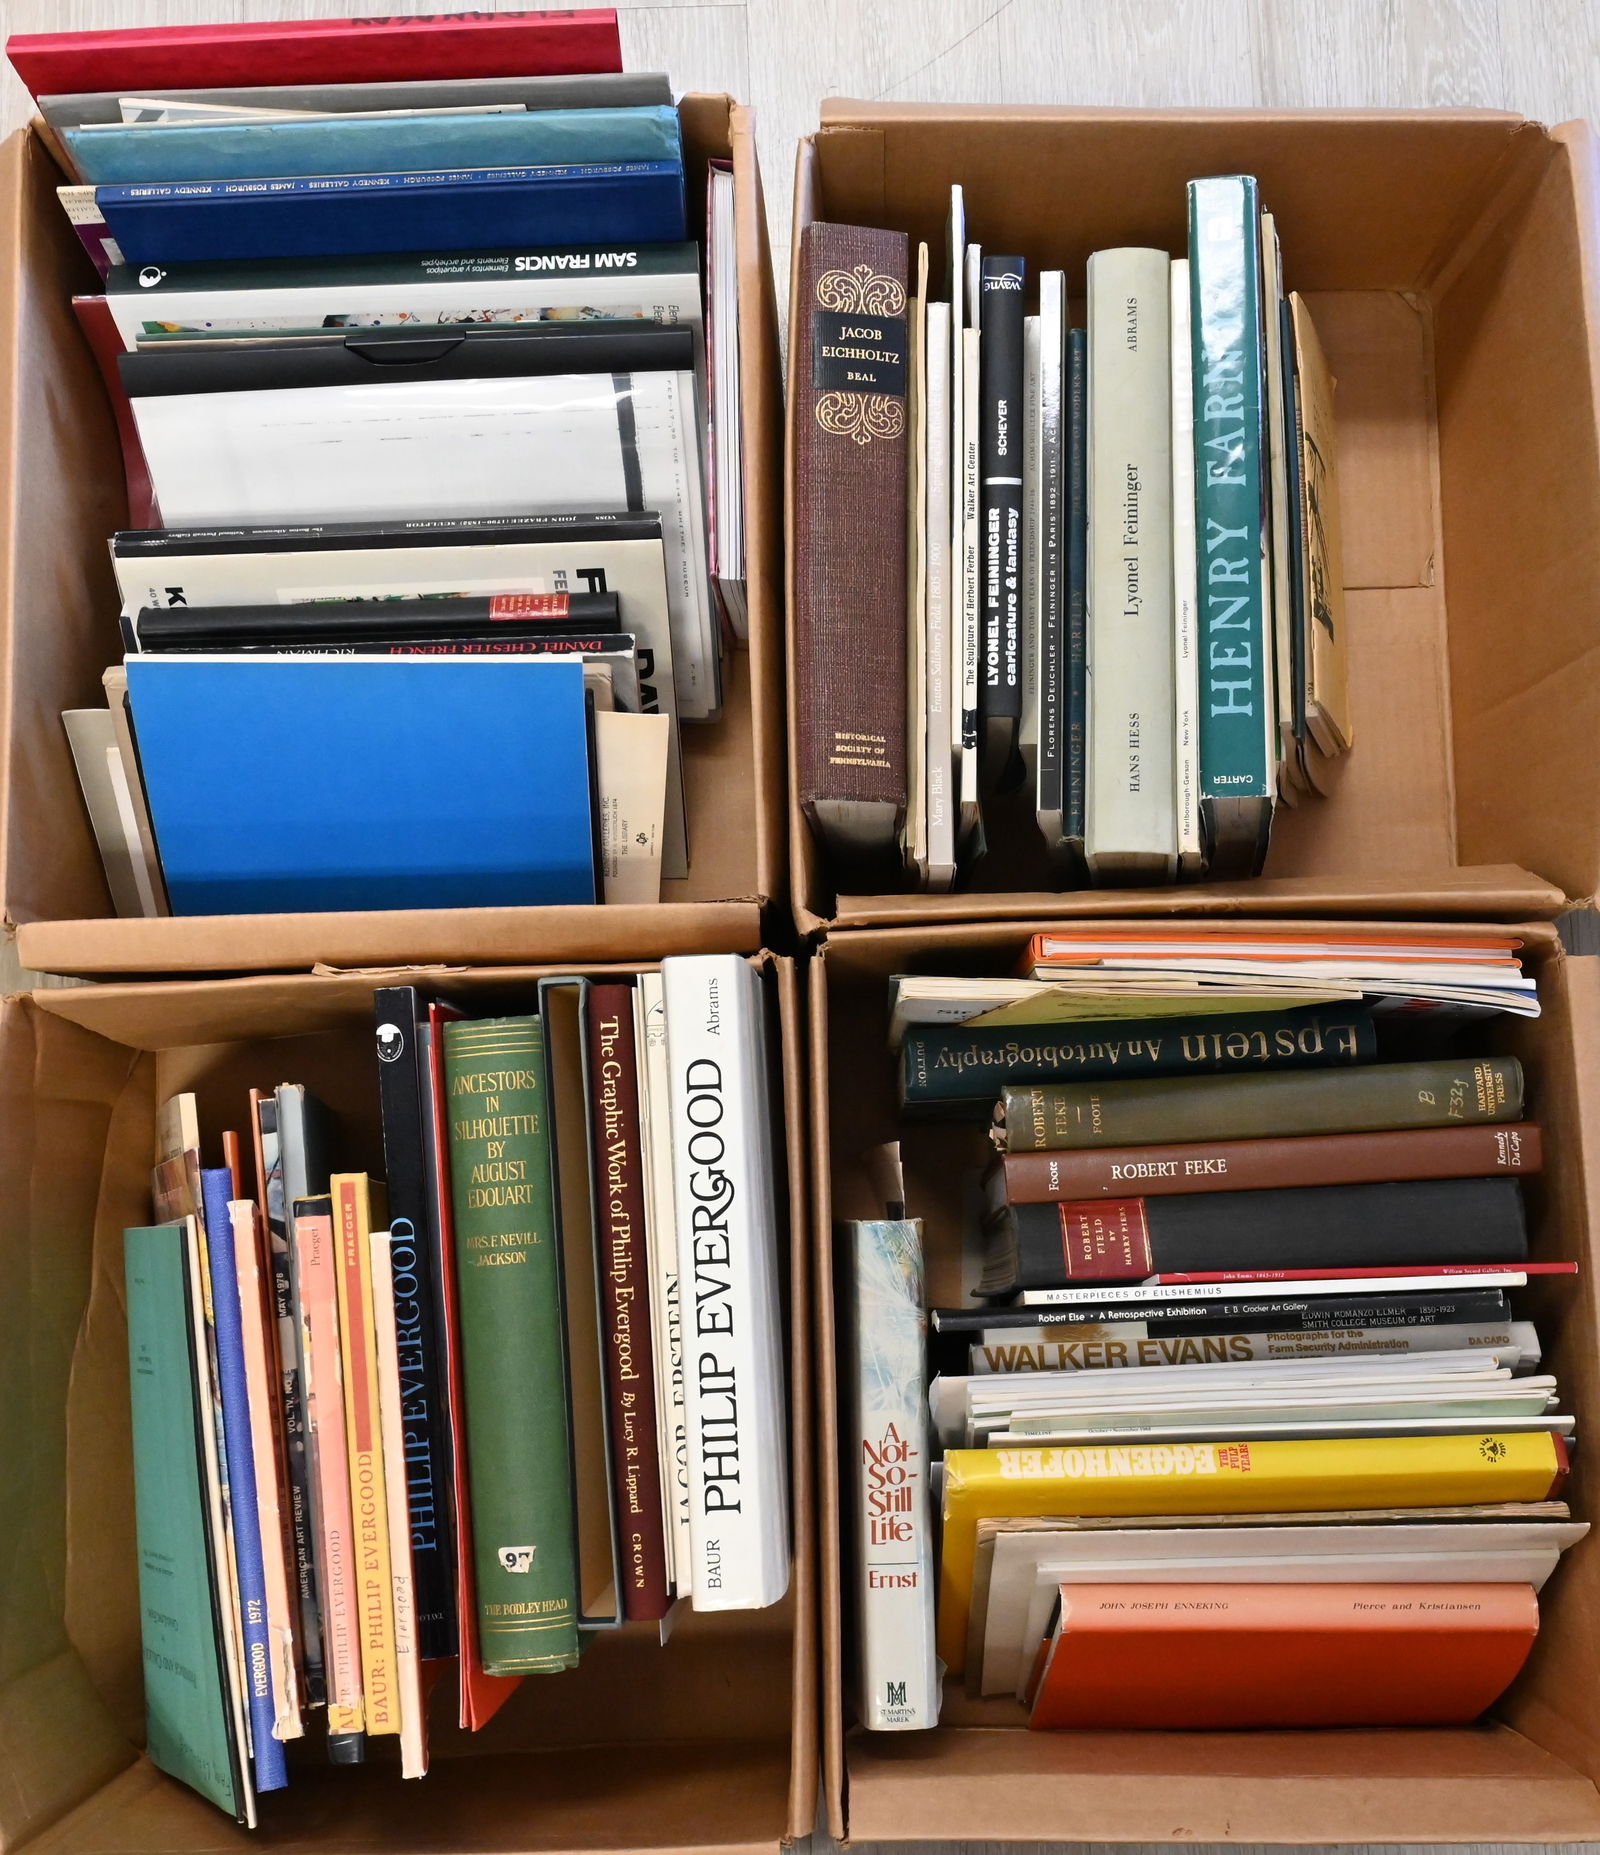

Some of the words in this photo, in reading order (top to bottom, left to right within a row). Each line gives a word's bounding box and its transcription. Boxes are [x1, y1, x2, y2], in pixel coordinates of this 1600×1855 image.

[130, 188, 171, 198] GALLERIES
[174, 186, 213, 196] KENNEDY
[225, 185, 268, 194] FOSBURGH
[270, 183, 296, 192] JAMES
[309, 180, 350, 189] GALLERIES
[514, 255, 591, 271] FRANCIS
[594, 252, 637, 268] SAM
[839, 326, 882, 340] JACOB
[1126, 297, 1137, 352] ABRAMS
[821, 347, 900, 364] EICHHOLTZ
[847, 371, 877, 382] BEAL
[997, 399, 1008, 456] SCHEYER
[966, 442, 976, 470] Center
[966, 473, 976, 487] Art
[966, 489, 976, 520] Walker
[1123, 463, 1142, 546] Feininger
[405, 522, 456, 530] SCULPTOR
[511, 518, 548, 526] FRAZEE
[550, 516, 577, 524] JOHN
[1005, 507, 1019, 573] fantasy
[1028, 517, 1036, 562] FRIENDSHIP
[966, 545, 976, 574] Ferber
[987, 507, 1001, 608] FEININGER
[966, 577, 976, 609] Herbert
[1005, 576, 1017, 590] &
[1123, 557, 1142, 617] Lyonel
[966, 613, 975, 622] of
[1071, 589, 1082, 663] HARTLEY
[1181, 599, 1189, 633] Feininger
[1206, 518, 1253, 718] HENRY
[390, 645, 457, 657] FRENCH
[462, 643, 538, 655] CHESTER
[541, 641, 603, 653] DANIEL
[965, 625, 976, 669] Sculpture
[987, 615, 1000, 687] LYONEL
[1005, 592, 1017, 687] caricature
[1181, 635, 1190, 659] Lyonel
[966, 670, 976, 686] The
[1027, 652, 1036, 694] FEININGER
[1128, 712, 1140, 749] HESS
[1183, 710, 1191, 727] York
[834, 732, 887, 743] HISTORICAL
[835, 744, 872, 754] SOCIETY
[1183, 733, 1191, 746] New
[829, 757, 891, 768] PENNSYLVANIA
[1071, 722, 1082, 816] FEININGER
[1129, 754, 1140, 793] HANS
[932, 766, 944, 795] Black
[1213, 774, 1253, 784] CARTER
[932, 797, 944, 826] Mary
[706, 978, 720, 1036] Abrams
[600, 1016, 621, 1057] The
[1127, 1039, 1163, 1062] An
[1181, 1016, 1358, 1068] Epstein
[915, 1041, 927, 1088] DUTTON
[934, 1041, 1123, 1075] Autobiography
[452, 1070, 536, 1096] ANCESTORS
[1473, 1066, 1486, 1113] HARVARD
[1482, 1063, 1496, 1116] UNIVERSITY
[1494, 1071, 1505, 1105] PRESS
[485, 1096, 500, 1113] IN
[599, 1061, 624, 1140] Graphic
[1090, 1095, 1103, 1135] FOOTE
[454, 1114, 540, 1141] SILHOUETTE
[1029, 1089, 1046, 1149] ROBERT
[1052, 1096, 1069, 1136] FEKE
[487, 1141, 506, 1159] BY
[1509, 1130, 1520, 1155] Capo
[471, 1160, 528, 1184] AUGUST
[606, 1139, 628, 1197] Work
[1048, 1161, 1060, 1192] Foote
[1111, 1160, 1178, 1181] ROBERT
[1184, 1158, 1228, 1176] FEKE
[1509, 1154, 1520, 1167] Da
[468, 1184, 534, 1209] EDOUART
[610, 1200, 630, 1220] of
[686, 1058, 735, 1338] EVERGOOD
[345, 1203, 357, 1266] PRAEGER
[1118, 1206, 1129, 1236] PIERS
[499, 1231, 540, 1248] NEVILL
[1079, 1214, 1093, 1261] ROBERT
[1093, 1218, 1106, 1255] FIELD
[1108, 1230, 1116, 1242] BY
[477, 1251, 526, 1268] JACKSON
[609, 1225, 633, 1283] Philip
[1123, 1239, 1133, 1266] HARRY
[277, 1297, 288, 1317] MAY
[1046, 1289, 1129, 1301] MASTERPIECES
[1134, 1289, 1149, 1298] OF
[1152, 1287, 1223, 1298] EILSHEMIUS
[389, 1216, 428, 1421] EVERGOOD
[1038, 1313, 1066, 1323] Robert
[1069, 1312, 1085, 1322] Else
[1099, 1312, 1106, 1321] A
[1108, 1309, 1164, 1322] Retrospective
[1166, 1307, 1207, 1318] Exhibition
[1243, 1304, 1270, 1314] Crocker
[1271, 1303, 1282, 1313] Art
[1283, 1302, 1308, 1315] Gallery
[1302, 1310, 1332, 1320] EDWIN
[1334, 1308, 1375, 1319] ROMANZO
[1302, 1319, 1330, 1330] SMITH
[1331, 1318, 1367, 1328] COLLEGE
[1370, 1317, 1406, 1327] MUSEUM
[1407, 1316, 1418, 1325] OF
[1419, 1315, 1437, 1324] ART
[613, 1286, 640, 1381] Evergood
[1267, 1331, 1329, 1343] Photographs
[1330, 1330, 1346, 1340] for
[1347, 1329, 1364, 1339] the
[1269, 1343, 1299, 1353] Farm
[1300, 1341, 1340, 1353] Security
[1342, 1338, 1409, 1350] Administration
[1468, 1337, 1481, 1346] DA
[1484, 1336, 1511, 1345] CAPO
[982, 1340, 1129, 1373] WALKER
[1136, 1334, 1254, 1368] EVANS
[620, 1391, 636, 1408] By
[622, 1412, 638, 1442] Lucy
[697, 1352, 742, 1516] PHILIP
[883, 1422, 902, 1445] A
[625, 1447, 638, 1461] R.
[862, 1438, 919, 1468] Not-
[996, 1445, 1217, 1480] EGGENHOFER
[1218, 1447, 1230, 1469] THE
[1228, 1446, 1240, 1469] PULP
[1238, 1443, 1252, 1472] YEARS
[625, 1465, 642, 1514] Lippard
[867, 1463, 918, 1490] So-
[293, 1485, 304, 1523] REVIEW
[403, 1432, 437, 1551] PHILIP
[867, 1486, 913, 1518] Still
[357, 1453, 380, 1571] EVERGOOD
[295, 1526, 304, 1544] ART
[870, 1515, 913, 1546] Life
[299, 1547, 311, 1599] AMERICAN
[328, 1530, 347, 1617] EVERGOOD
[631, 1533, 645, 1588] CROWN
[706, 1539, 722, 1590] BAUR
[868, 1569, 918, 1589] Ernst
[247, 1599, 263, 1625] 1972
[365, 1579, 384, 1649] PHILIP
[484, 1603, 502, 1616] THE
[502, 1600, 542, 1616] BODLEY
[542, 1598, 568, 1612] HEAD
[1099, 1602, 1126, 1611] JOHN
[1130, 1602, 1169, 1611] JOSEPH
[1174, 1602, 1230, 1611] ENNEKING
[1352, 1602, 1387, 1611] Pierce
[1391, 1602, 1413, 1611] and
[1418, 1602, 1482, 1611] Kristiansen
[336, 1624, 350, 1675] PHILIP
[251, 1642, 269, 1697] EVERGOOD
[370, 1658, 389, 1724] BAUR:
